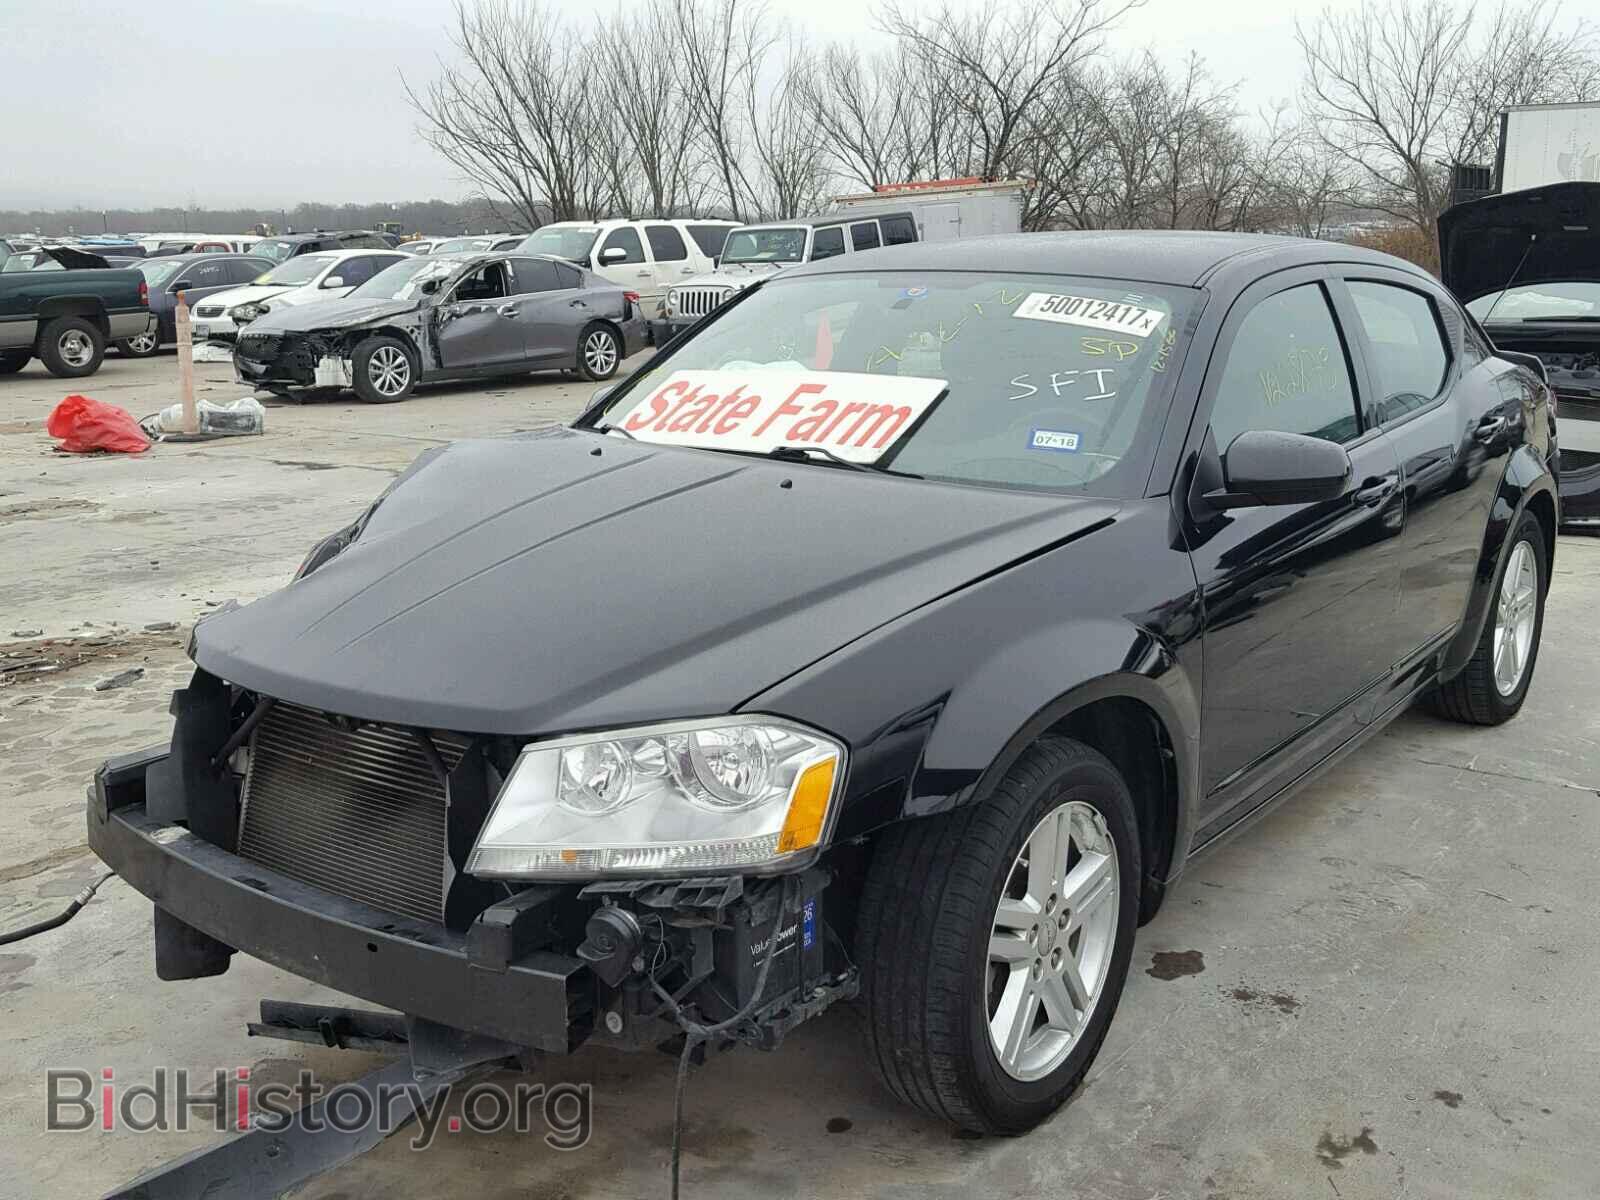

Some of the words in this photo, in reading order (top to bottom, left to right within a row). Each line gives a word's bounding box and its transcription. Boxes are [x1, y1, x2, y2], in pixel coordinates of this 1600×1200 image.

[1009, 368, 1117, 401] SFI
[625, 380, 762, 436] State
[752, 383, 913, 449] Farm
